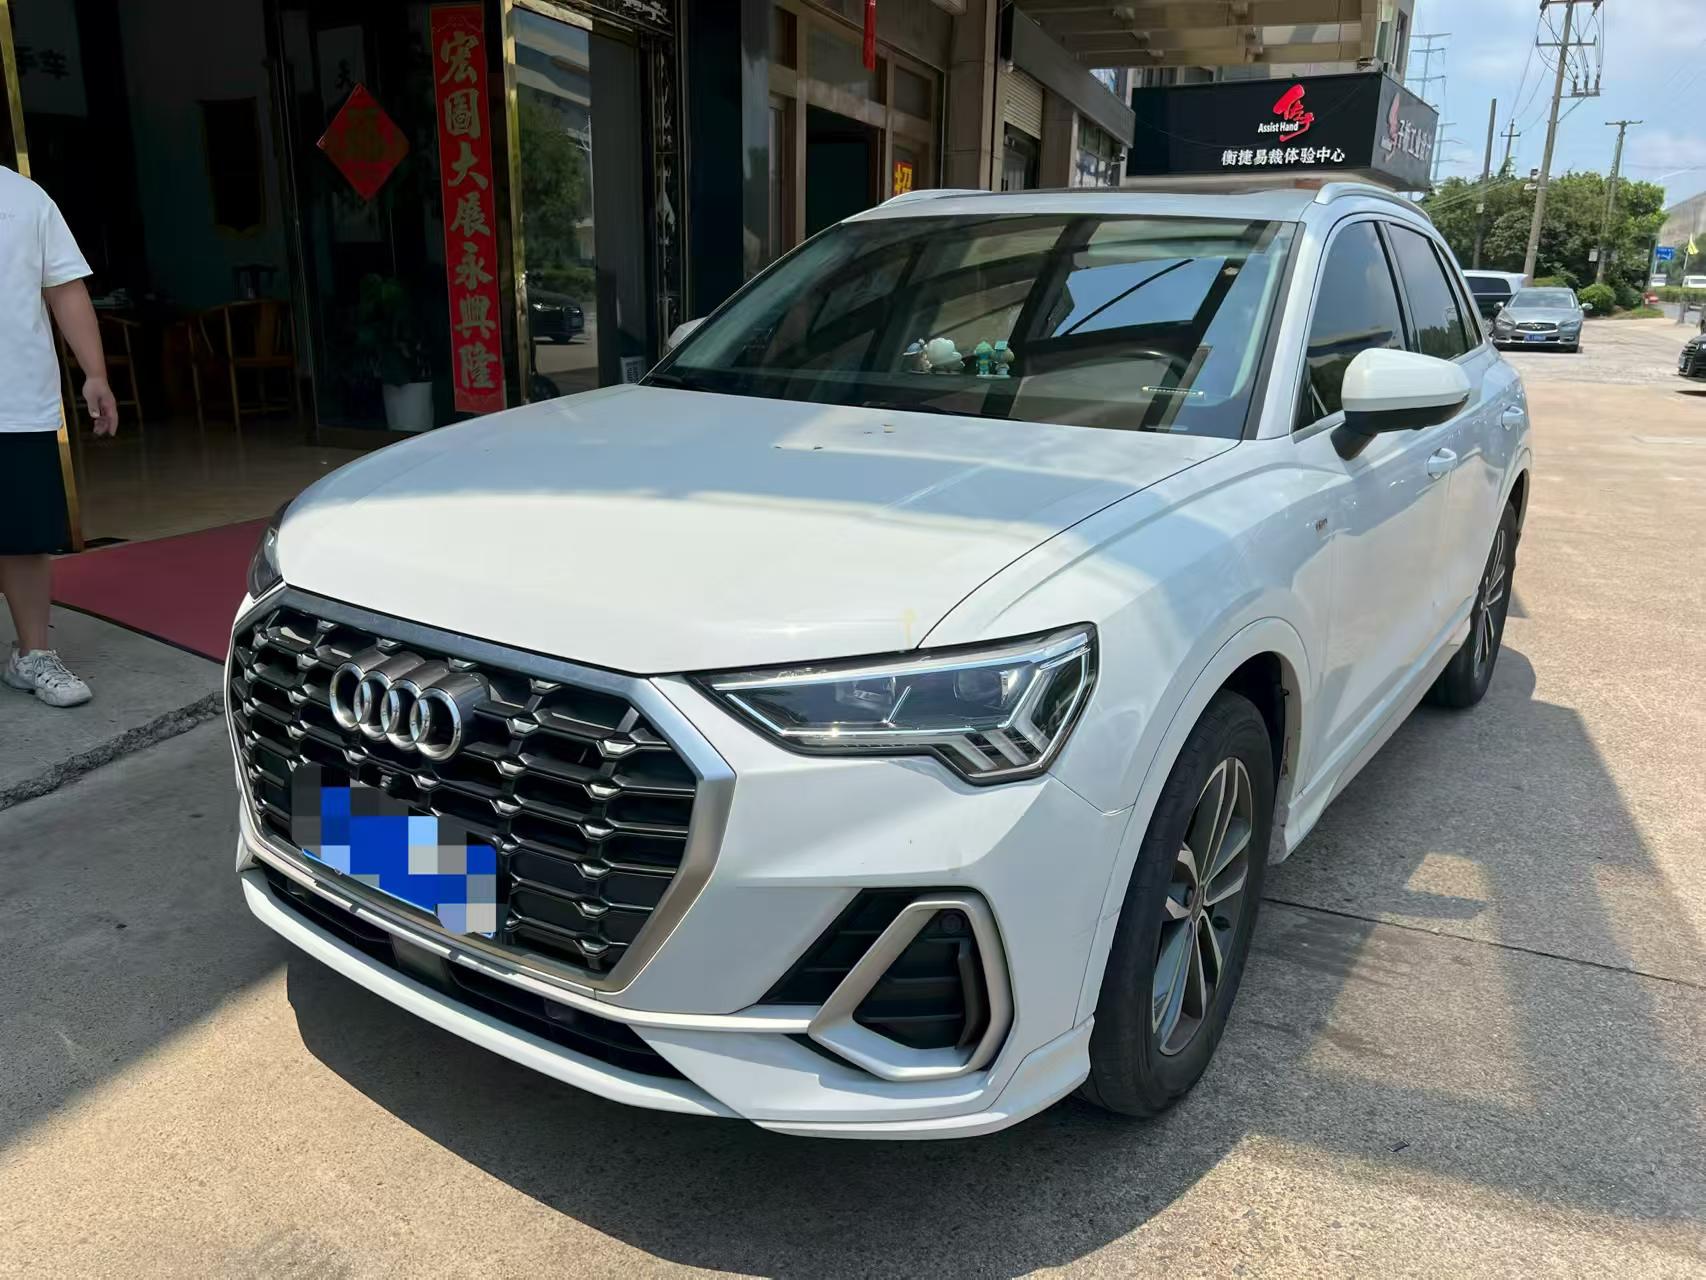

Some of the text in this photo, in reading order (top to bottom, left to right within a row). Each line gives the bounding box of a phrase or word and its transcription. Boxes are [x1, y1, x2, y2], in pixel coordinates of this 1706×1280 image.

[439, 30, 497, 391] 宏圖大展永興隆
[1257, 121, 1299, 133] Assist Hand
